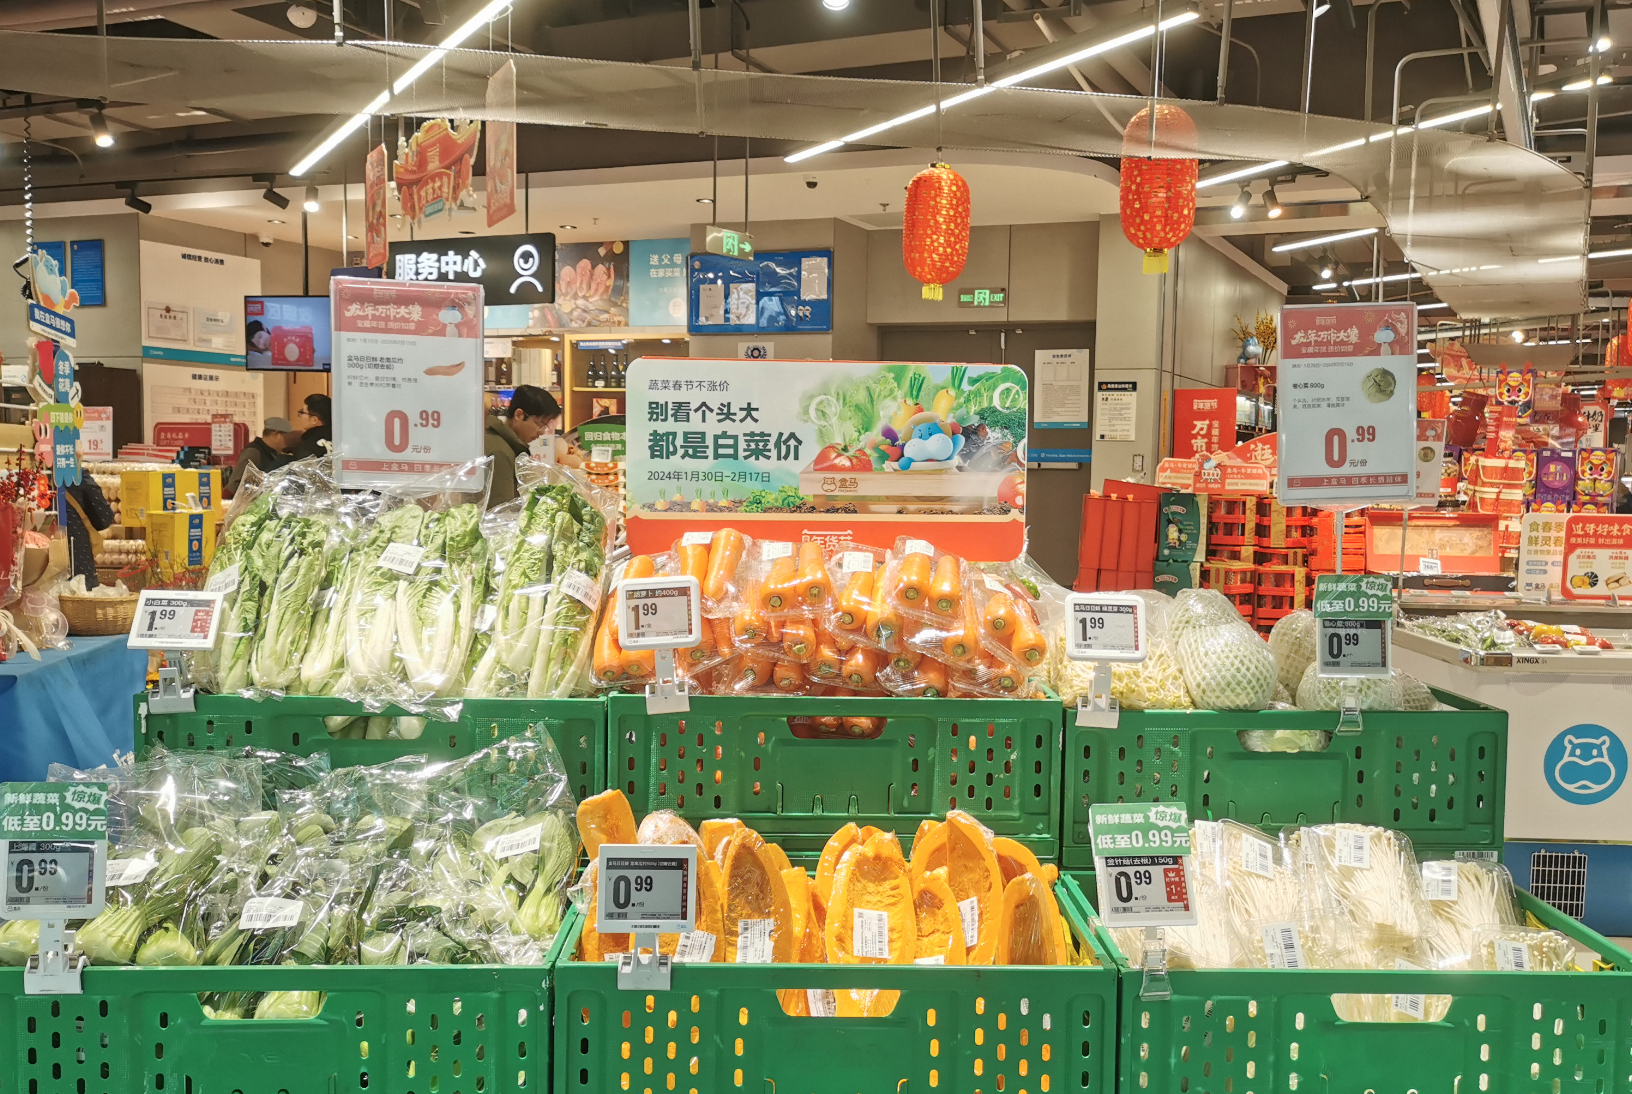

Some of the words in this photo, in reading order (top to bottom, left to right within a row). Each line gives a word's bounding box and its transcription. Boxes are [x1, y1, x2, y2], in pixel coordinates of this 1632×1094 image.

[394, 250, 487, 281] 服务中心
[649, 253, 683, 266] 送父母
[649, 268, 682, 278] 在家买菜
[990, 293, 1004, 302] EXIT
[648, 379, 730, 392] 蔬菜春节不涨价
[1309, 382, 1325, 390] 800g
[647, 401, 760, 424] 别看个头大
[647, 430, 803, 461] 都是白菜价
[838, 477, 858, 489] 盒马
[1318, 582, 1358, 592] 新鲜蔬菜
[1316, 597, 1392, 613] 低至0.99元
[4, 792, 60, 805] 新鲜蔬菜
[2, 811, 107, 832] 低至0.99元
[1095, 813, 1145, 824] 新鲜蔬菜
[1096, 830, 1190, 849] 低至0.99元
[1154, 856, 1173, 864] 150g
